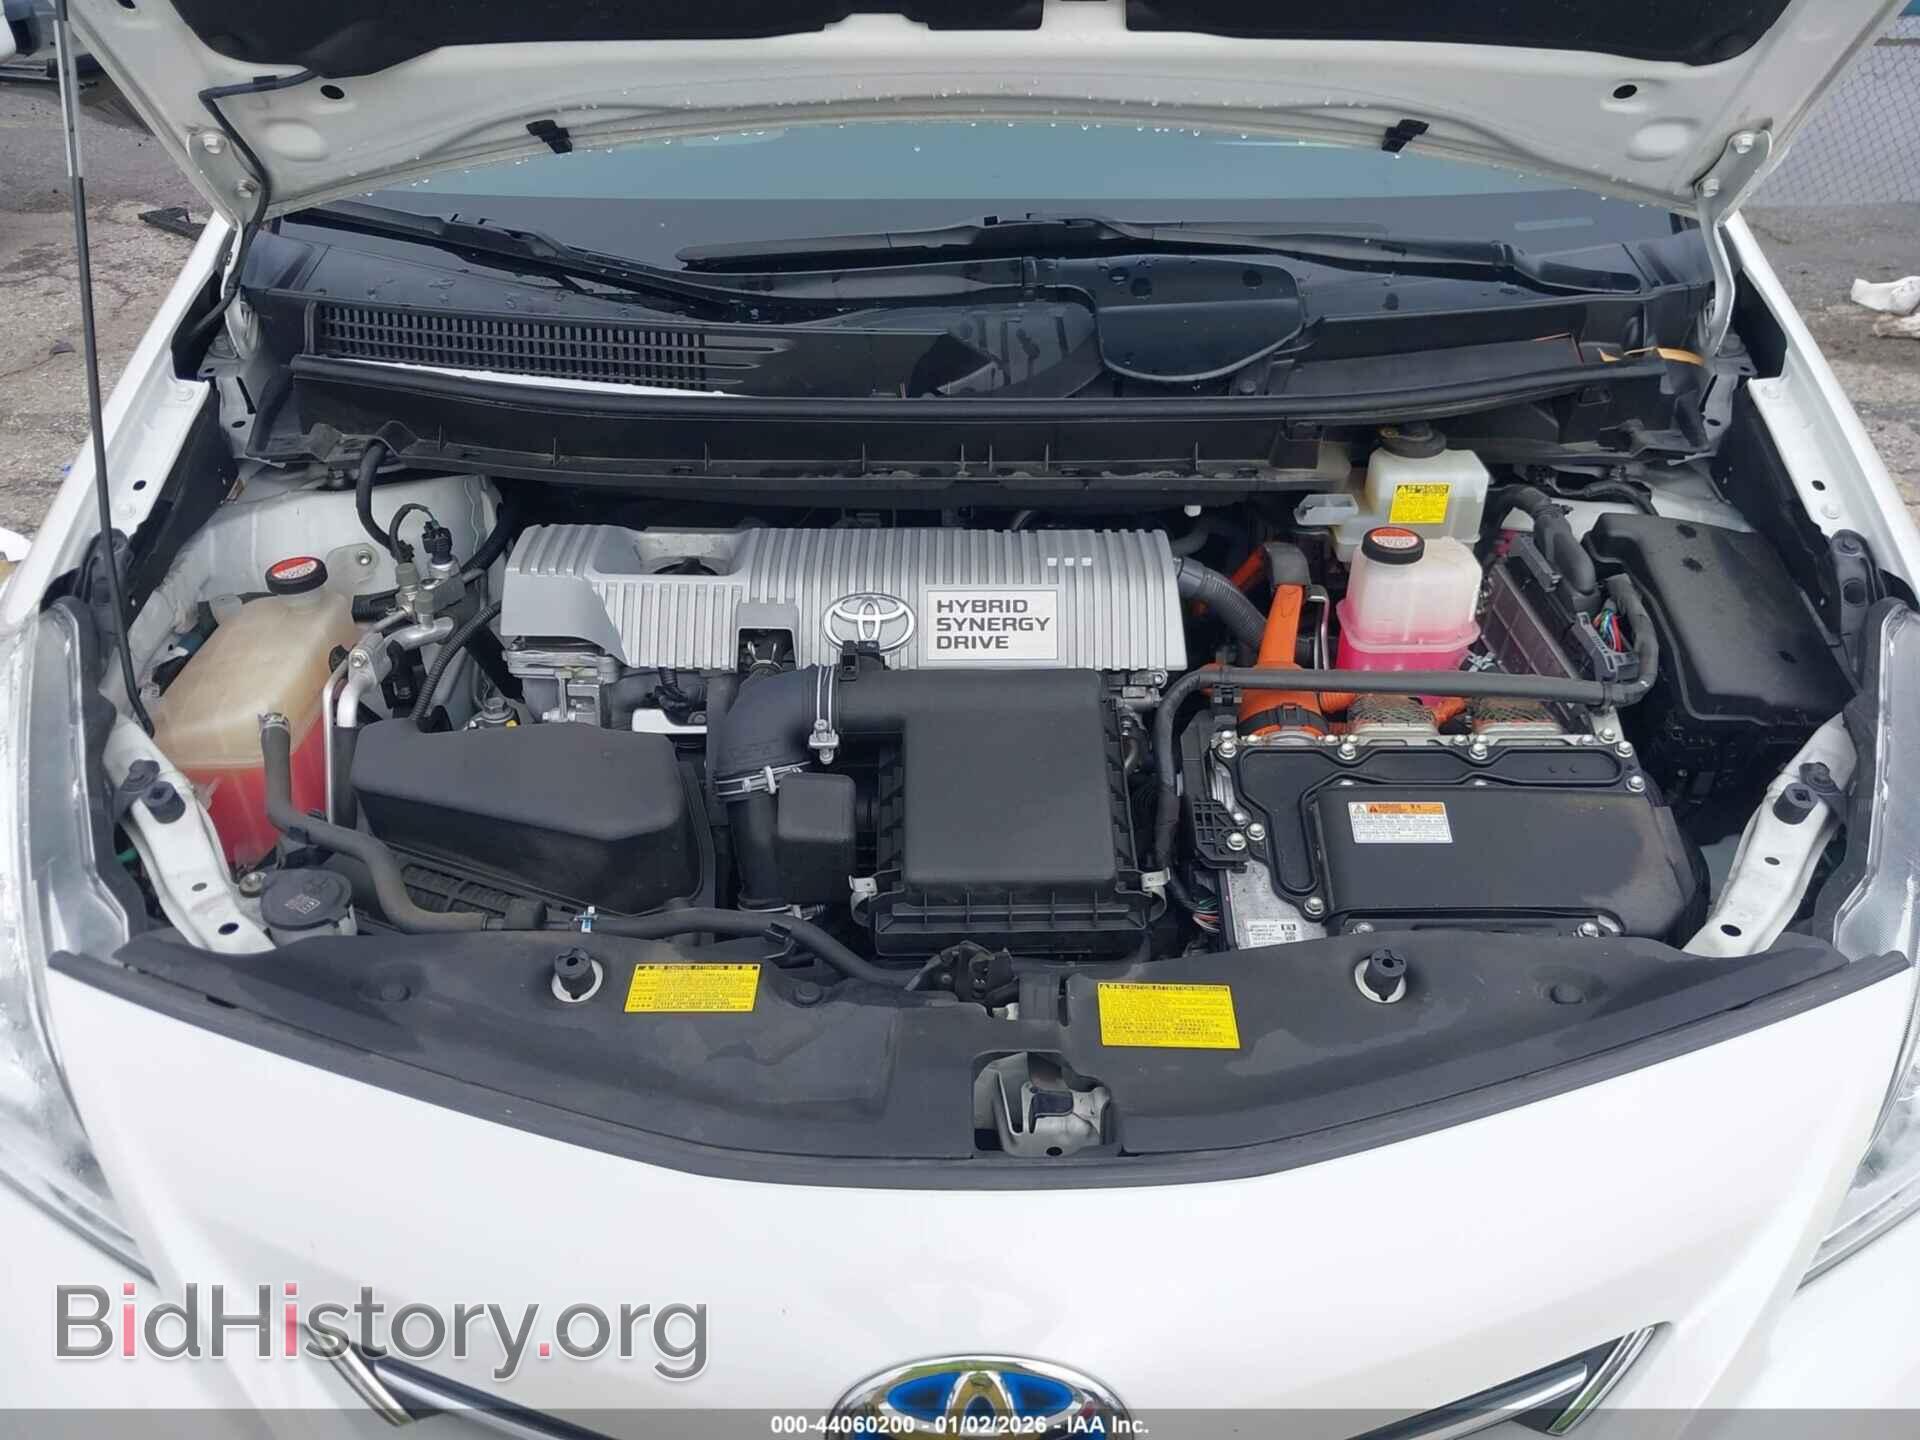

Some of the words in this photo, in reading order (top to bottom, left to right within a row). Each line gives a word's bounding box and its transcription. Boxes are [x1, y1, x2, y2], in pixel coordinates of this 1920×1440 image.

[937, 599, 1028, 613] HYBRID
[936, 617, 1050, 631] SYNERGY
[936, 635, 1009, 649] DRIVE
